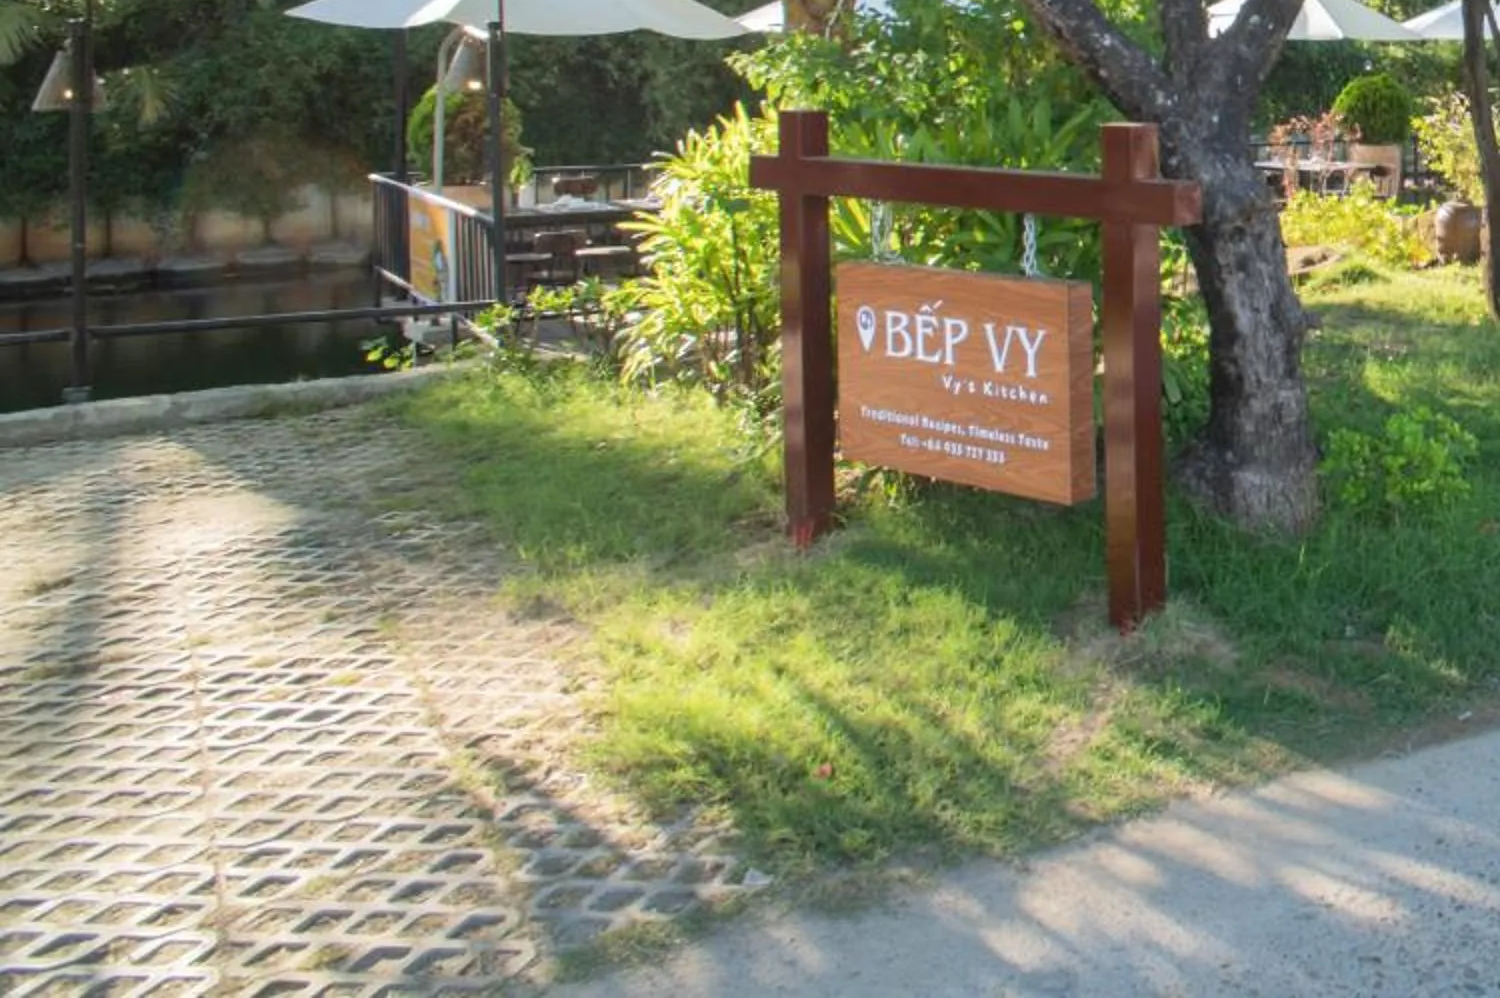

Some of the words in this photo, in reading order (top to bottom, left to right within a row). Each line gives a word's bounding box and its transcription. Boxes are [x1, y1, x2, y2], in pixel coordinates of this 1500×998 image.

[885, 299, 969, 365] BẾP
[983, 322, 1047, 378] VY
[983, 381, 1049, 405] Kitchen
[860, 405, 919, 427] Traditional
[967, 424, 1016, 445] Timeless
